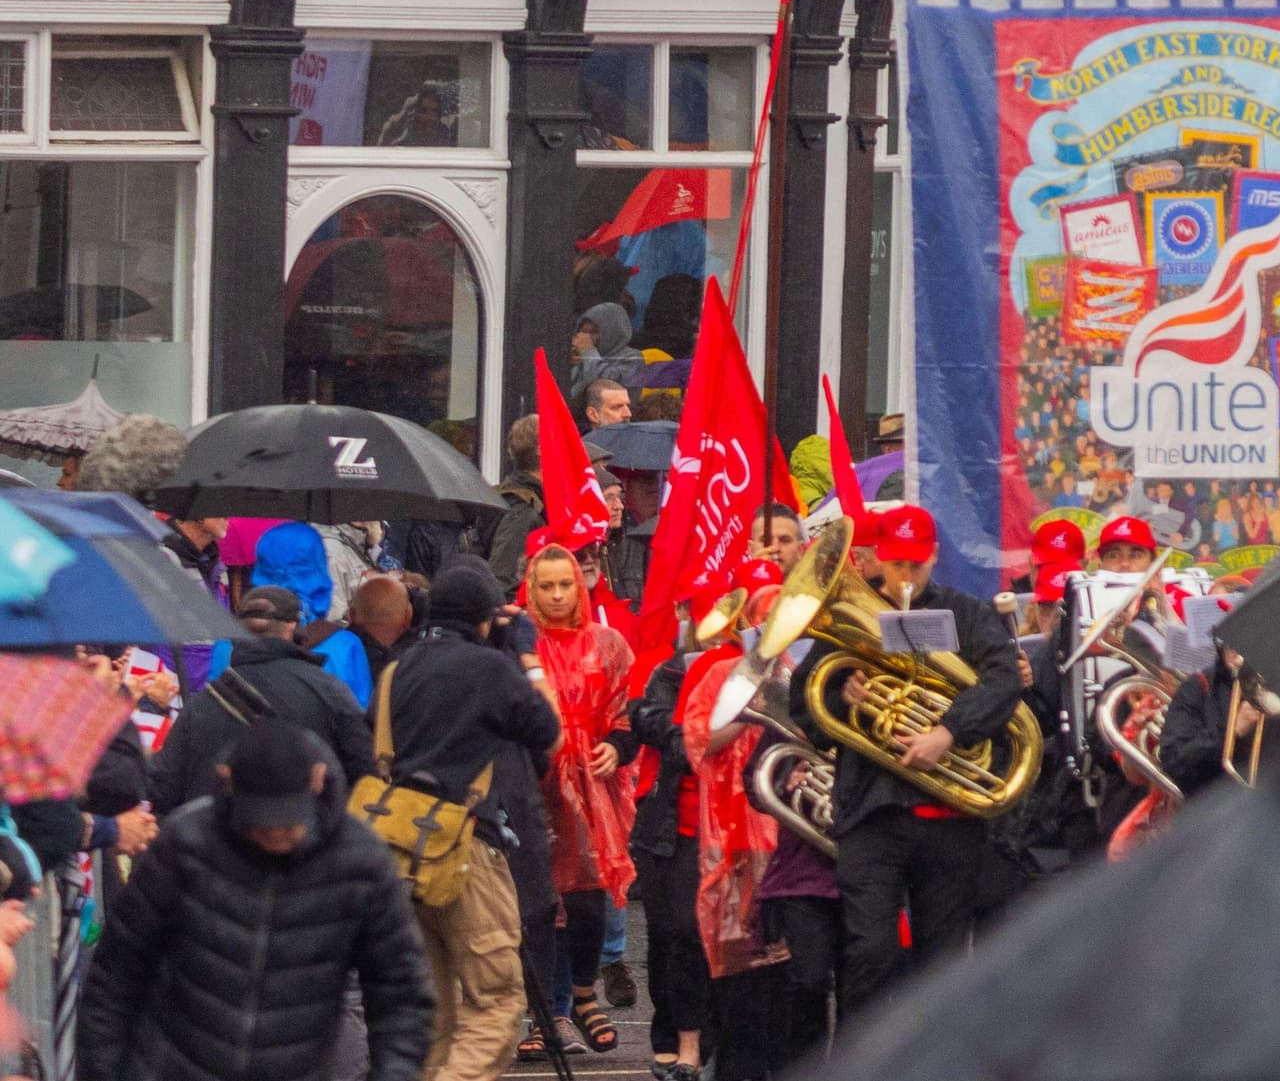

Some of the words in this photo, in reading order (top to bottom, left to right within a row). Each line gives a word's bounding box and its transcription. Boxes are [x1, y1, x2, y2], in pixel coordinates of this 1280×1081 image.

[1050, 50, 1128, 101] NORTH
[1137, 34, 1200, 69] EAST
[1183, 67, 1222, 85] AND
[1080, 93, 1236, 166] HUMBERSIDE
[1074, 220, 1130, 244] amicus
[1102, 371, 1267, 432] unite
[328, 436, 375, 467] Z
[1147, 443, 1267, 465] theUNION
